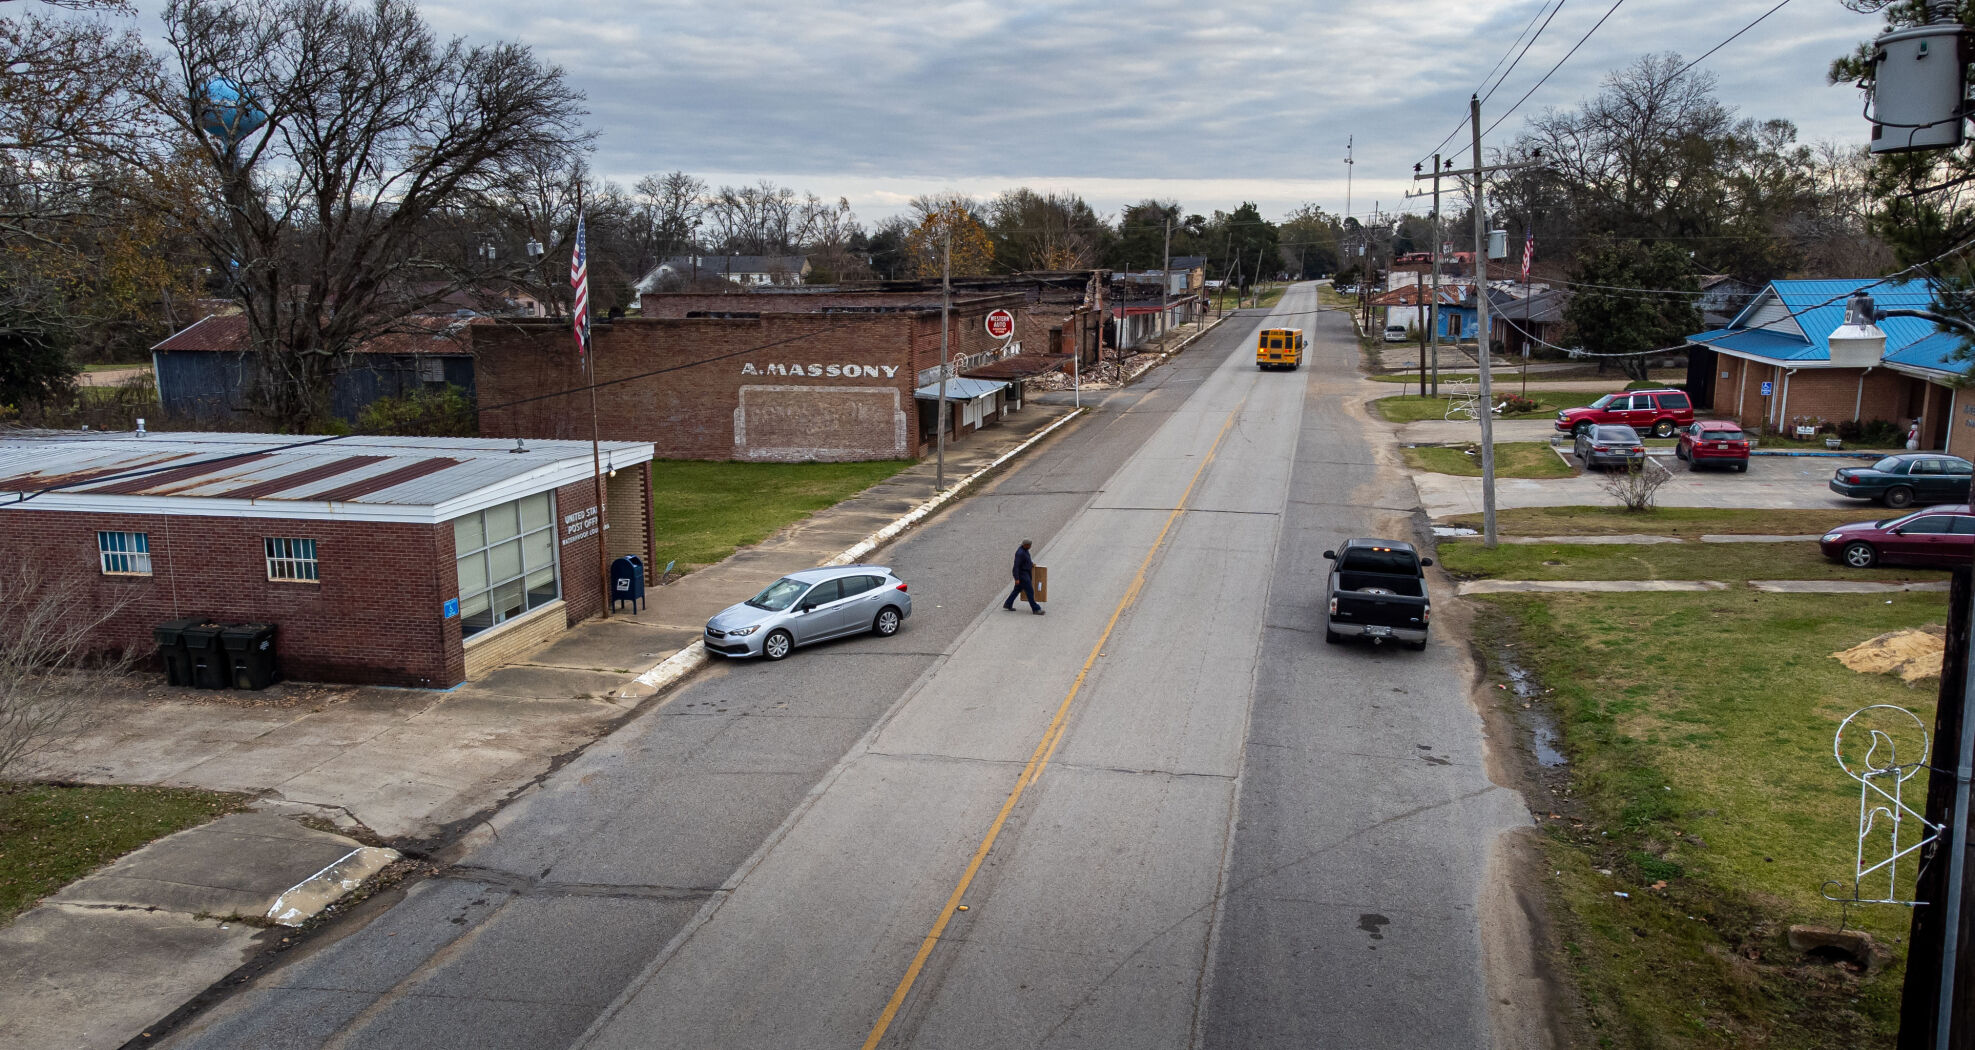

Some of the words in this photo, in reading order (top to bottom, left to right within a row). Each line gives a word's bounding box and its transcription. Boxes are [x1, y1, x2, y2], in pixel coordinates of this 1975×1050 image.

[564, 510, 585, 525] UNITED
[567, 522, 583, 535] POST
[584, 516, 598, 528] OFFI
